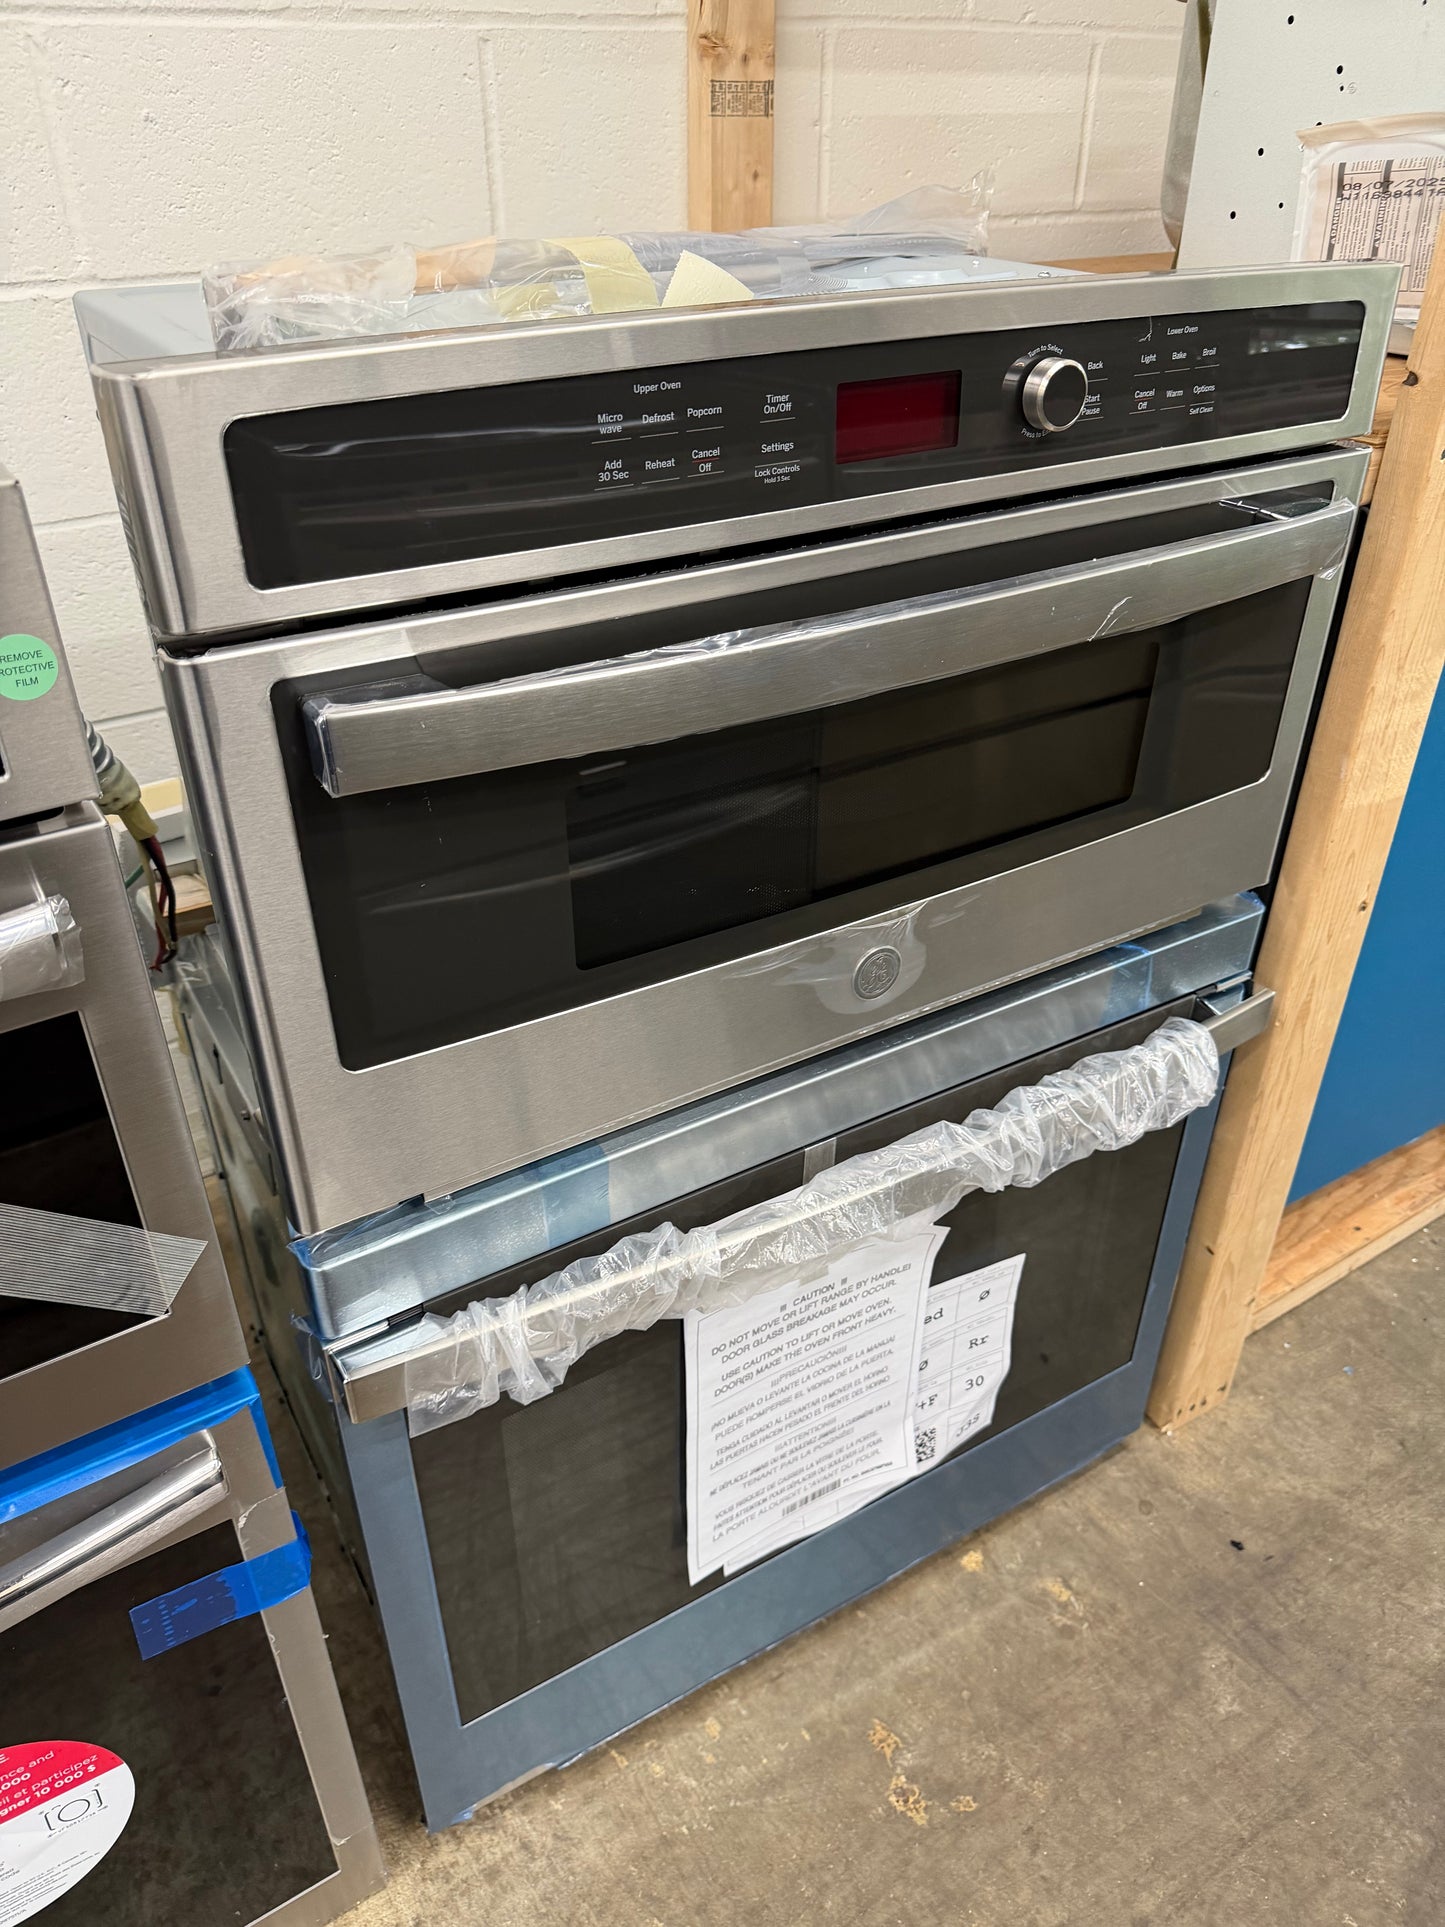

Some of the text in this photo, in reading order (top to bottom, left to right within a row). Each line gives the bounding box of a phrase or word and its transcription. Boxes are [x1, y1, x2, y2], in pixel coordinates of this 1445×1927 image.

[1167, 326, 1199, 336] Lower Oven
[1028, 347, 1040, 358] Turn
[1047, 343, 1064, 355] Select
[1141, 347, 1217, 365] Light Bake Broil
[1088, 360, 1104, 370] Back
[633, 380, 682, 395] Upper Oven
[1134, 384, 1216, 398] Cancel Warm Options
[766, 393, 790, 404] Timer
[1085, 394, 1100, 403] Start
[1138, 401, 1148, 410] Off
[597, 405, 723, 424] Micro Defrost Popcorn
[763, 402, 792, 415] On/Off
[1081, 407, 1101, 416] Pause
[1189, 406, 1214, 416] Self Clean
[599, 424, 623, 435] wave
[1021, 428, 1035, 438] Press
[692, 446, 721, 460] Cancel
[760, 441, 794, 454] Settings
[604, 458, 676, 471] Add Reheat
[698, 462, 712, 474] Off
[754, 464, 801, 479] Lock Controls
[598, 470, 630, 483] 30 Sec
[764, 476, 776, 484] Hold
[782, 474, 791, 482] Sec
[0, 649, 44, 664] REMOVE
[15, 676, 39, 688] FILM
[792, 1282, 836, 1307] CAUTION
[711, 1343, 727, 1356] DO
[728, 1330, 751, 1348] NOT
[751, 1317, 781, 1337] MOVE
[782, 1309, 797, 1321] OR
[799, 1299, 819, 1316] LIFT
[820, 1284, 854, 1305] RANGE
[855, 1277, 869, 1290] BY
[721, 1279, 897, 1364] DOOR GLASS BREAKAGE MAY OCCUR.
[721, 1297, 892, 1382] USE CAUTION TO LIFT OR MOVE OVEN.
[968, 1334, 990, 1350] Rr
[714, 1306, 897, 1398] DOOR(S) MAKE THE OVEN FRONT HEAVY.
[727, 1401, 756, 1421] MUEVA
[756, 1397, 764, 1406] O
[764, 1379, 800, 1402] LEVANTE
[801, 1374, 811, 1385] LA
[812, 1361, 842, 1379] COCINA
[843, 1353, 854, 1363] DE
[855, 1349, 865, 1359] LA
[964, 1374, 985, 1391] 30
[715, 1420, 745, 1441] PUEDE
[745, 1394, 793, 1424] ROMPERSE
[835, 1368, 848, 1380] DE
[848, 1364, 860, 1374] LA
[716, 1439, 741, 1457] TENGA
[28, 1750, 55, 1768] and
[13, 1787, 28, 1799] et
[31, 1754, 98, 1791] participez
[33, 1786, 51, 1798] 10
[54, 1770, 84, 1789] 000
[87, 1764, 96, 1773] $
